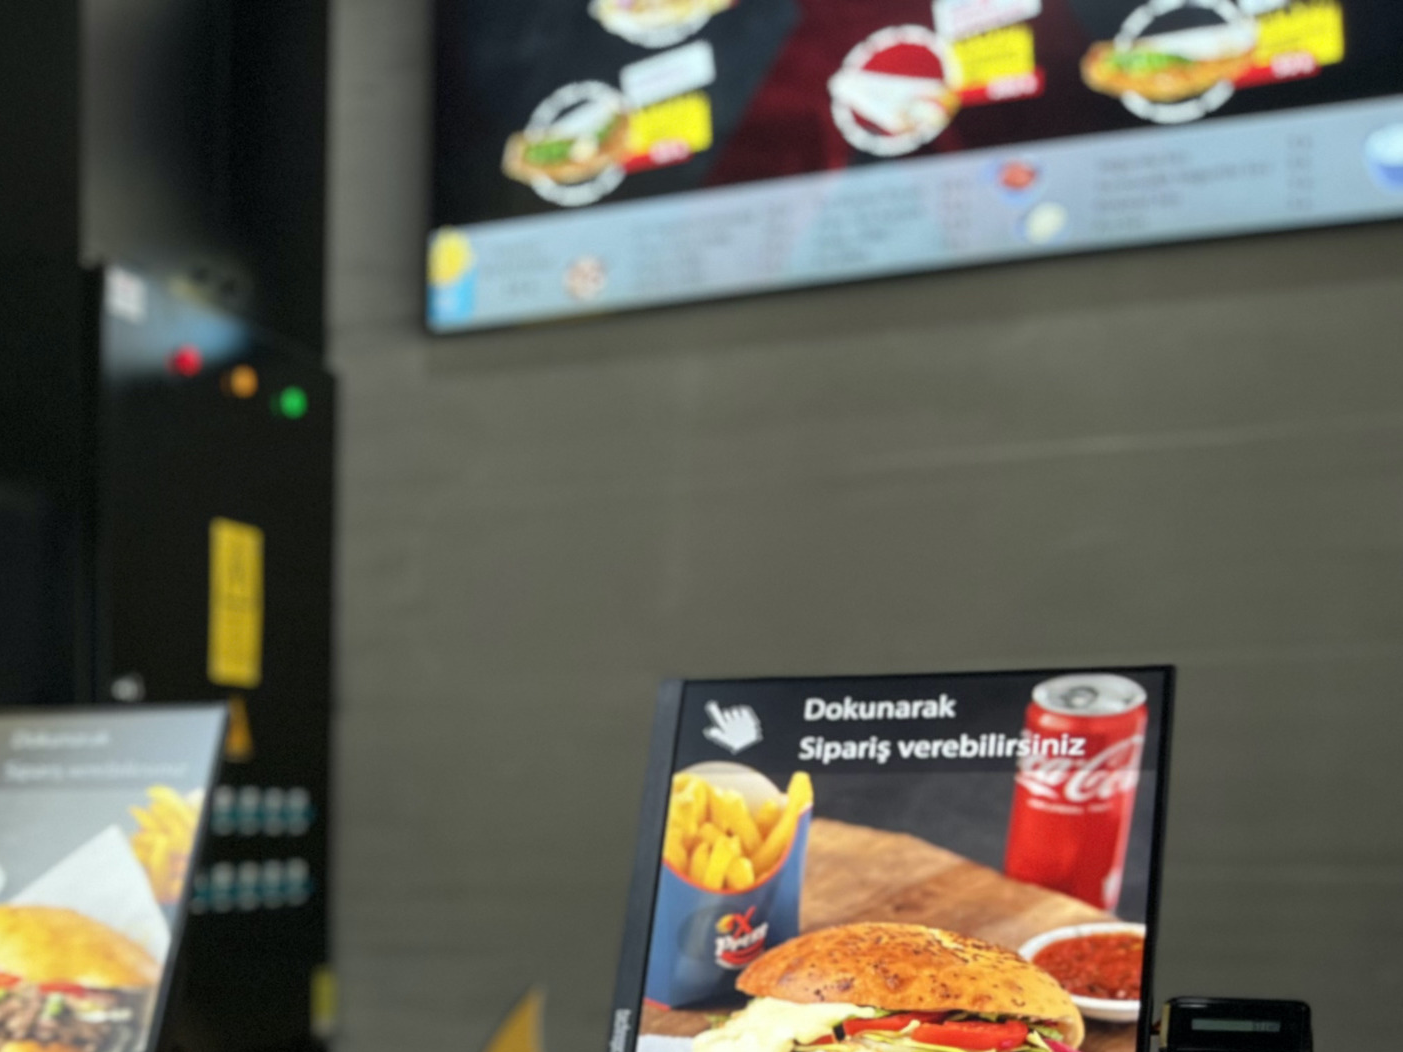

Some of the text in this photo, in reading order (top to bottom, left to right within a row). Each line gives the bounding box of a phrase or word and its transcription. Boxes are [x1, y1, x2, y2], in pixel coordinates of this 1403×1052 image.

[803, 694, 957, 721] Dokunarak
[798, 732, 1087, 765] Sipariş verebilirsiniz
